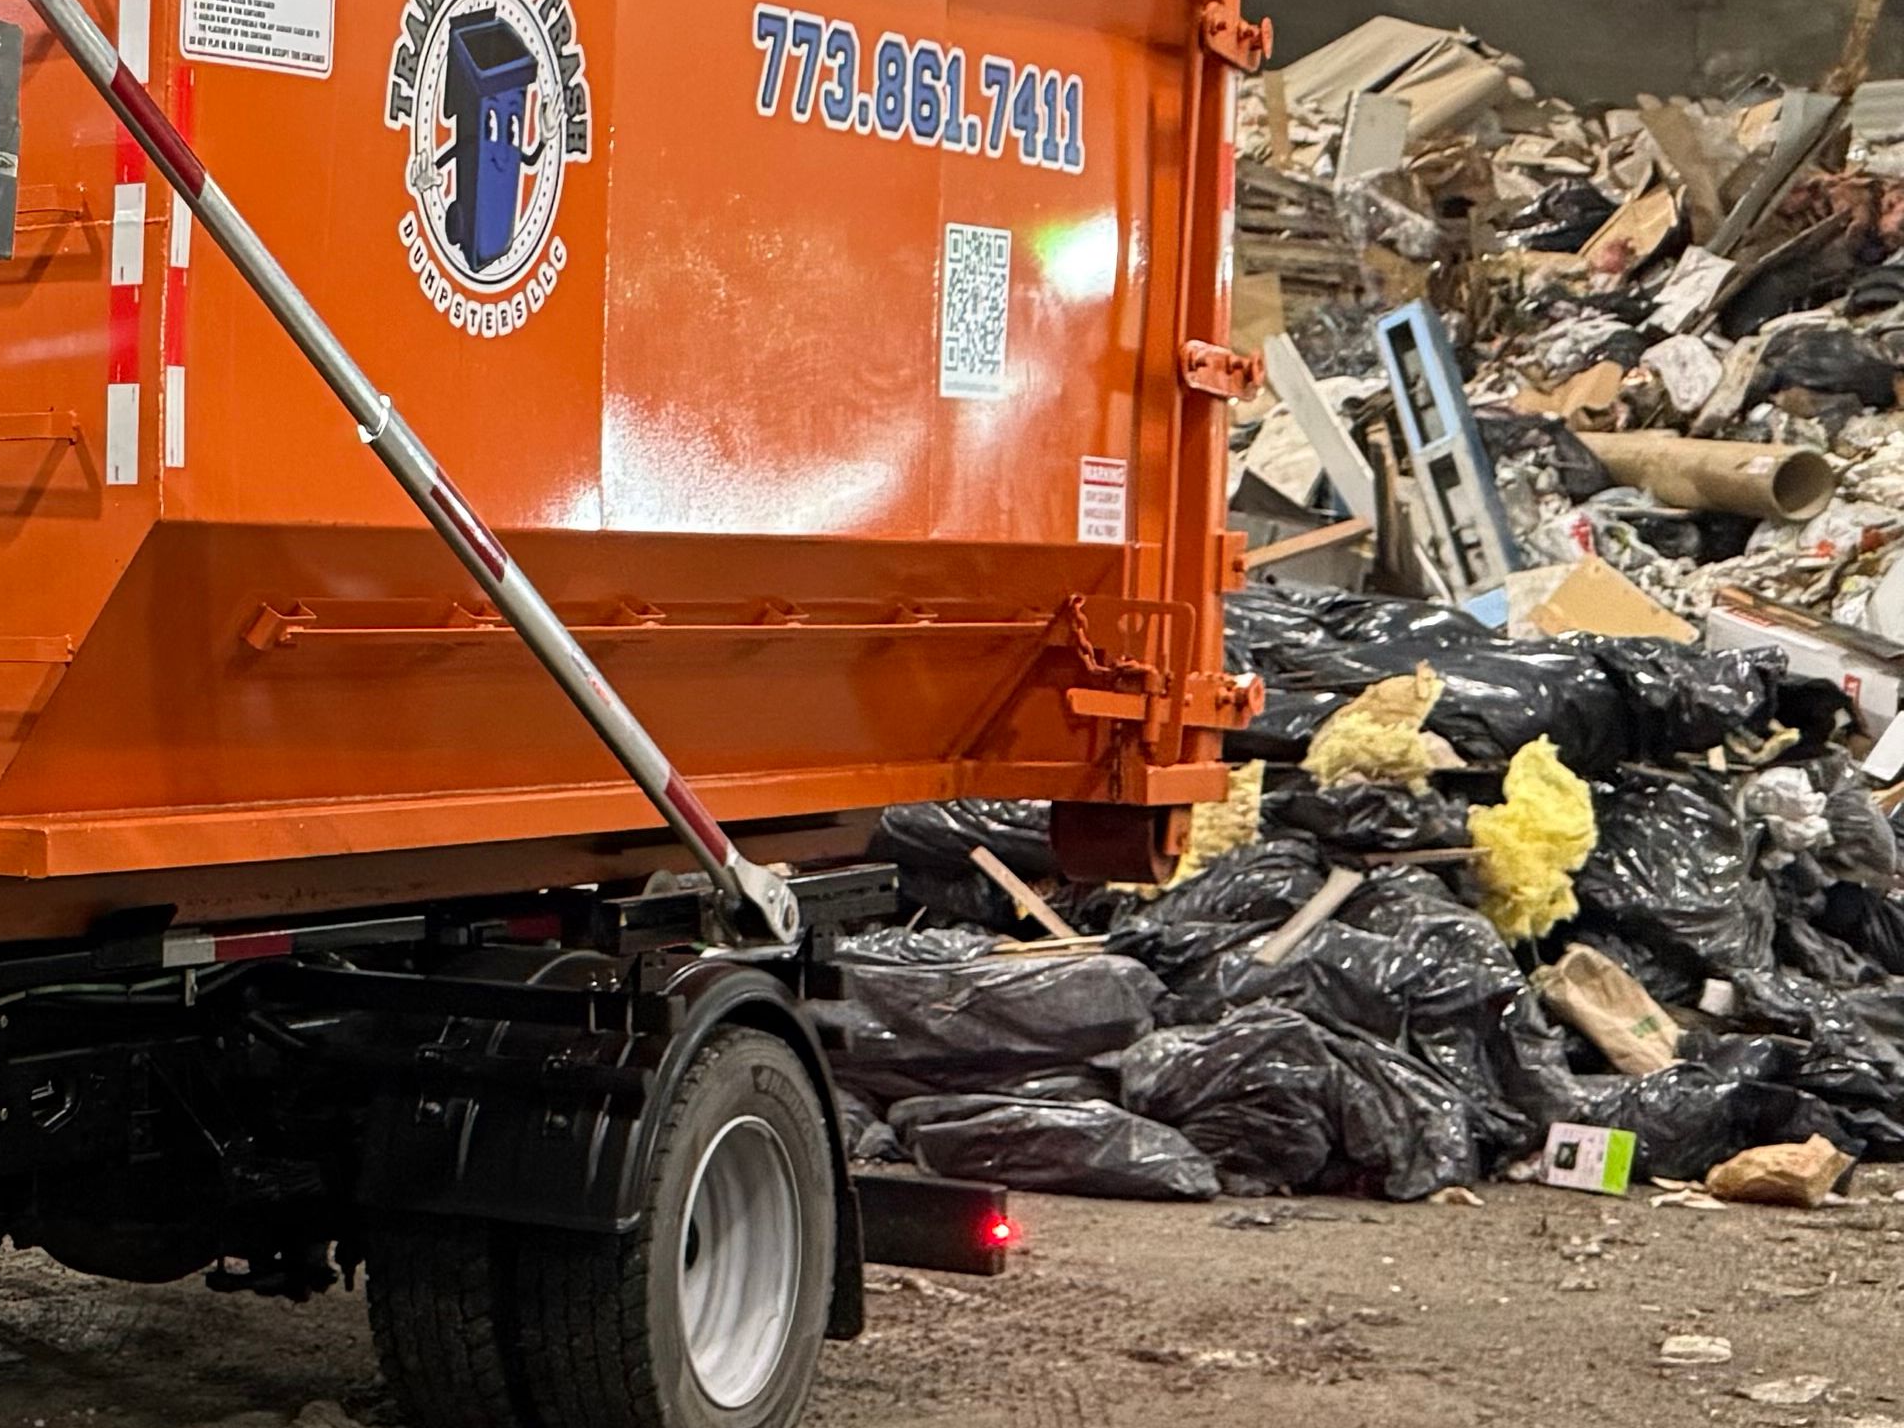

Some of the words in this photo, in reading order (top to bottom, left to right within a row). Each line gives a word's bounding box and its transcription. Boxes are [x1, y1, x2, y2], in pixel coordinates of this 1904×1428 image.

[755, 7, 1084, 171] 773.861.7411
[403, 218, 525, 331] DUMPSTERS
[529, 244, 566, 303] LLC
